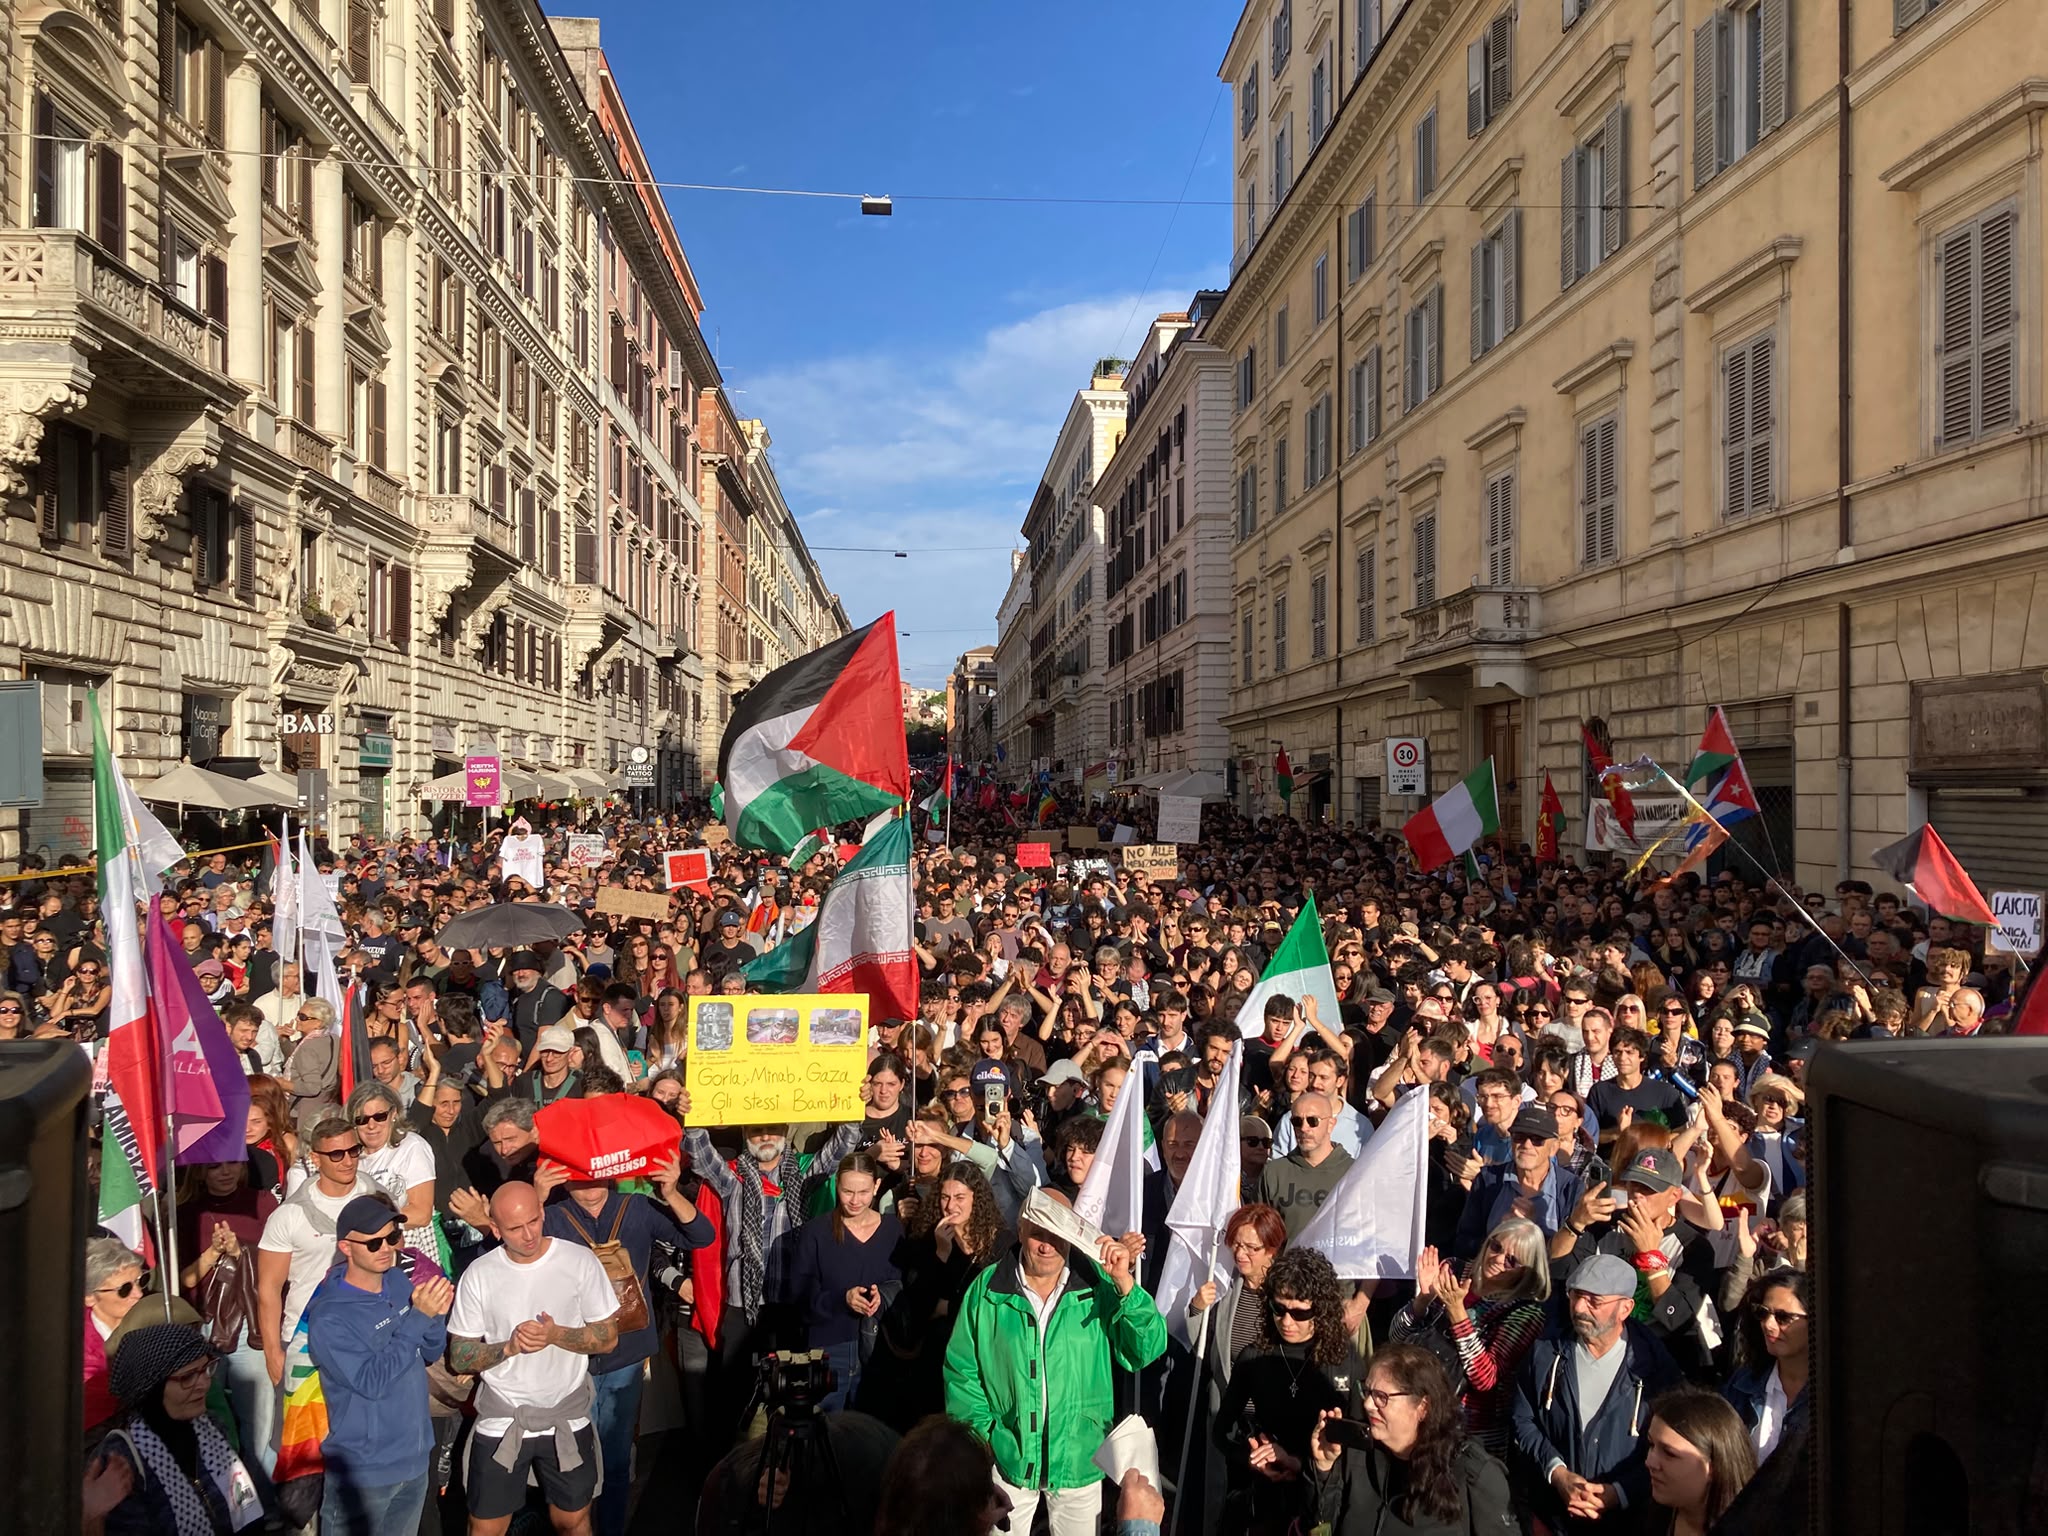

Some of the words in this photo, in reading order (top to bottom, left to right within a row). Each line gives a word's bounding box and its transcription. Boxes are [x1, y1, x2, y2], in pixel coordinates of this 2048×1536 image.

[283, 713, 335, 734] BAR
[1399, 749, 1413, 760] 30
[1126, 847, 1145, 859] NO
[1151, 846, 1175, 857] ALLE
[1126, 858, 1178, 868] MENZOGNE
[805, 1062, 853, 1083] Gaza
[976, 1070, 1007, 1081] ellesse
[711, 1091, 732, 1111] Gli
[743, 1093, 780, 1111] stessi
[105, 1103, 154, 1198] AMICIZIA
[590, 1148, 631, 1170] FRONTE
[593, 1155, 647, 1179] DISSENSO
